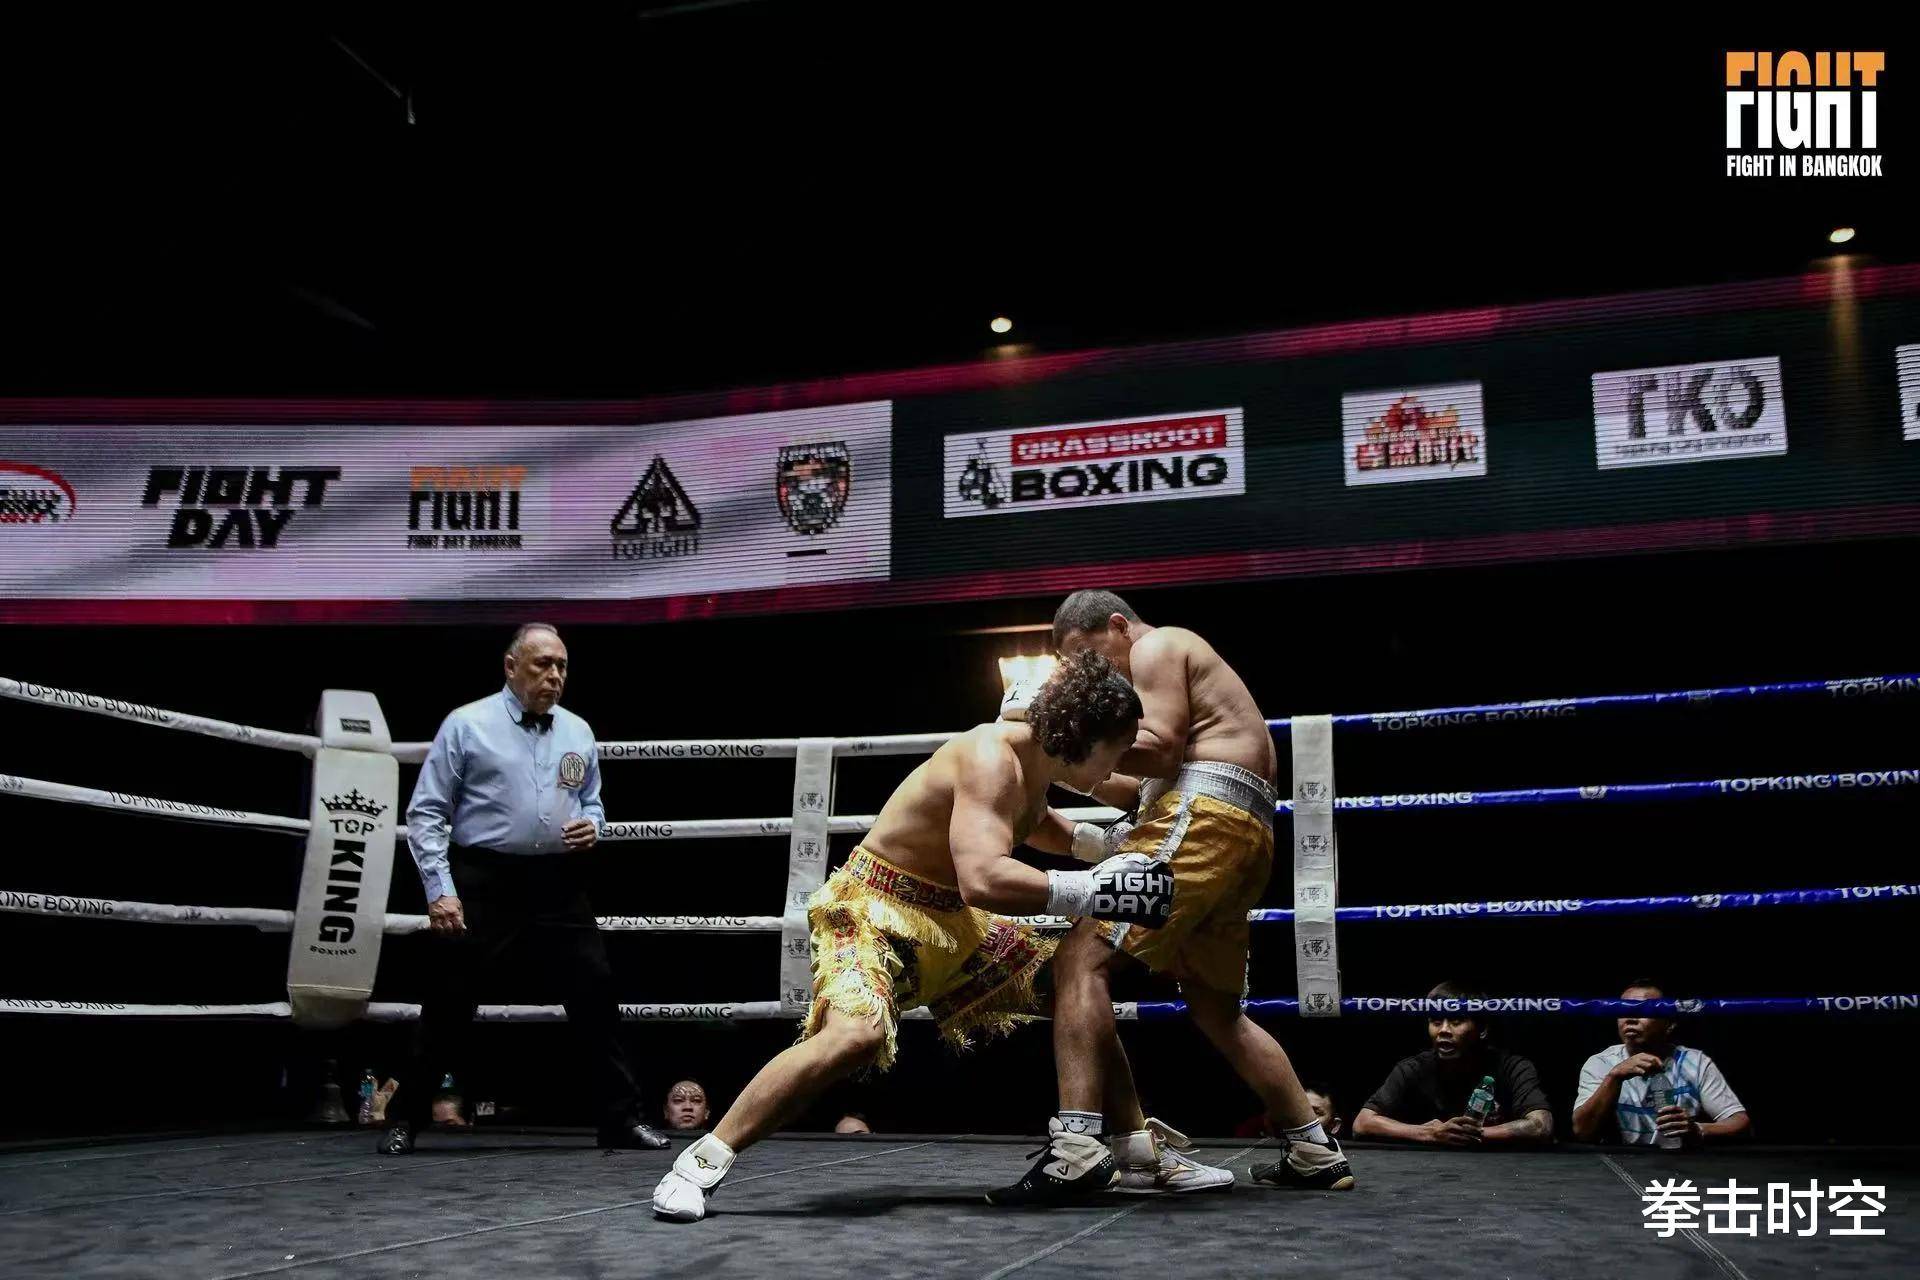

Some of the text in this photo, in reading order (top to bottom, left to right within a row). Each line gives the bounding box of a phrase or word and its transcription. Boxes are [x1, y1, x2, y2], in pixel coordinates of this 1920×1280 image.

[141, 465, 342, 509] FIGHT
[1011, 453, 1230, 502] BOXING
[166, 508, 299, 550] DAY
[602, 743, 765, 758] TOPKING BOXING
[1715, 774, 1832, 793] TOPKING
[1380, 791, 1474, 807] BOXING
[329, 818, 375, 836] TOP
[602, 823, 673, 838] BOXING
[318, 838, 367, 945] KING
[1094, 872, 1174, 896] FIGHT
[43, 895, 114, 915] BOXING
[1094, 894, 1160, 915] DAY
[1374, 898, 1582, 919] TOPKING BOXING
[309, 945, 358, 957] BOXING
[658, 1006, 733, 1019] BOXING
[1352, 996, 1561, 1012] TOPKING BOXING
